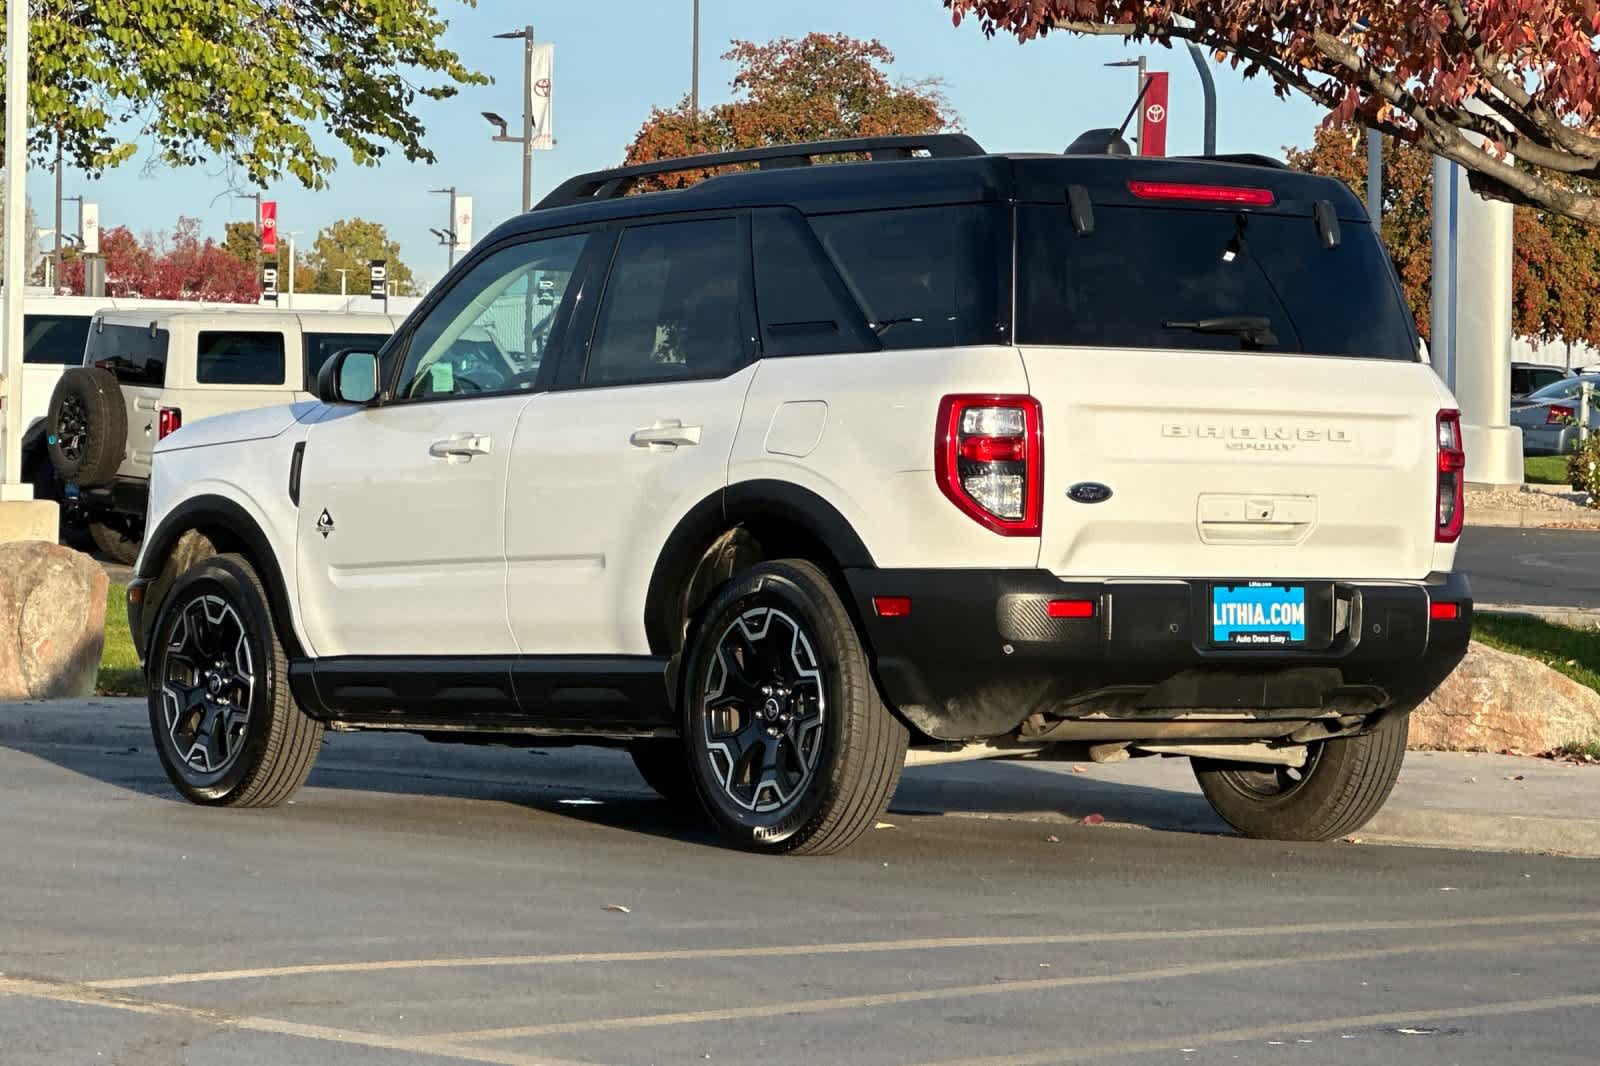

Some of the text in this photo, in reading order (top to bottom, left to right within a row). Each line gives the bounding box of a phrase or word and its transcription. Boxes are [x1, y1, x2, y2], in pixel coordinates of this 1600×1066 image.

[1161, 423, 1353, 443] BRONCO
[1213, 602, 1305, 626] LITHIA.COM
[1236, 634, 1286, 644] Auto Done Easy
